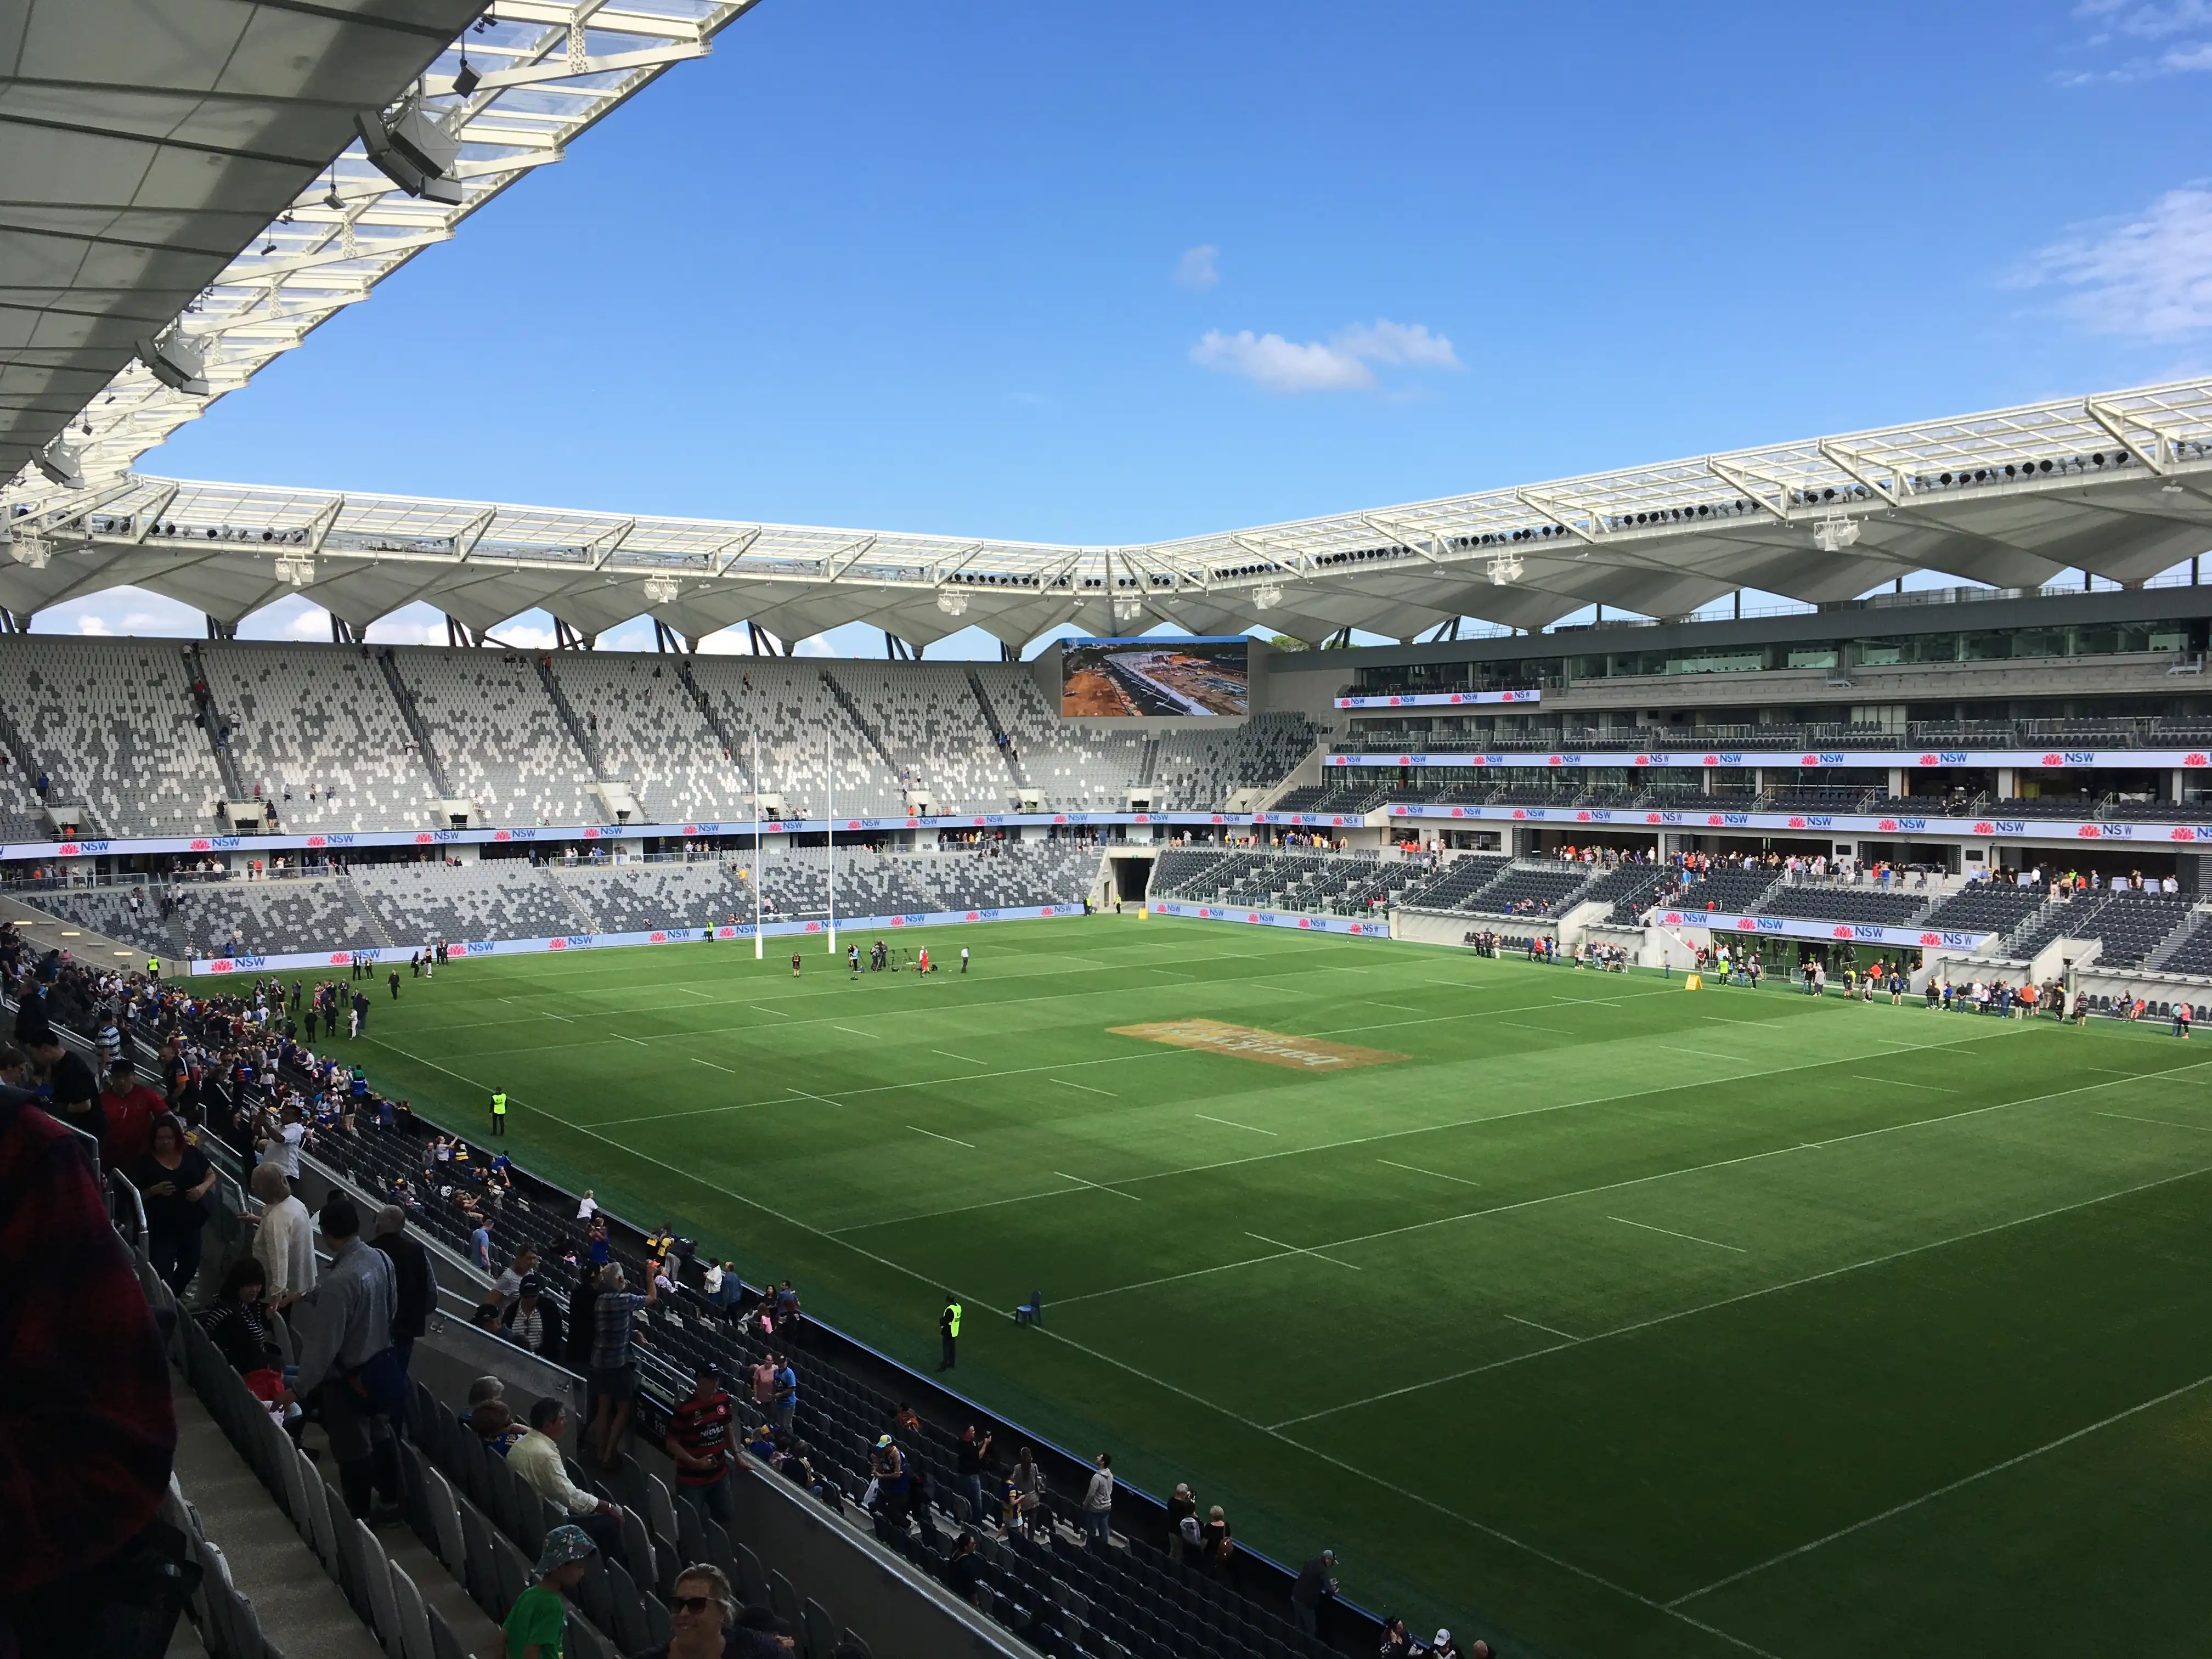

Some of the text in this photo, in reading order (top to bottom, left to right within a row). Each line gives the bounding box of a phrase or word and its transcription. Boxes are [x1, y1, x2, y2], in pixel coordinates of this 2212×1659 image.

[1940, 753, 1967, 762] NSW
[2065, 753, 2094, 762] NSW
[1592, 811, 1611, 819] NSW
[1662, 812, 1682, 821] NSW
[1725, 815, 1747, 823] NSW
[1807, 816, 1832, 826] NSW
[1899, 819, 1926, 828] NSW
[1996, 822, 2025, 831] NSW
[2103, 824, 2132, 834] NSW
[435, 832, 459, 840] NSW
[512, 830, 535, 838] NSW
[212, 838, 240, 847] NSW
[328, 835, 353, 843] NSW
[81, 842, 109, 850] NSW
[1683, 912, 1707, 923] NSW
[822, 919, 842, 928] NW
[1757, 919, 1783, 929] NSW
[668, 929, 690, 938] NSW
[736, 925, 757, 934] NSW
[1855, 927, 1883, 938] NSW
[568, 935, 592, 945] NSW
[1944, 933, 1972, 944] NSW
[468, 943, 494, 951] NSW
[235, 957, 265, 967] NSW
